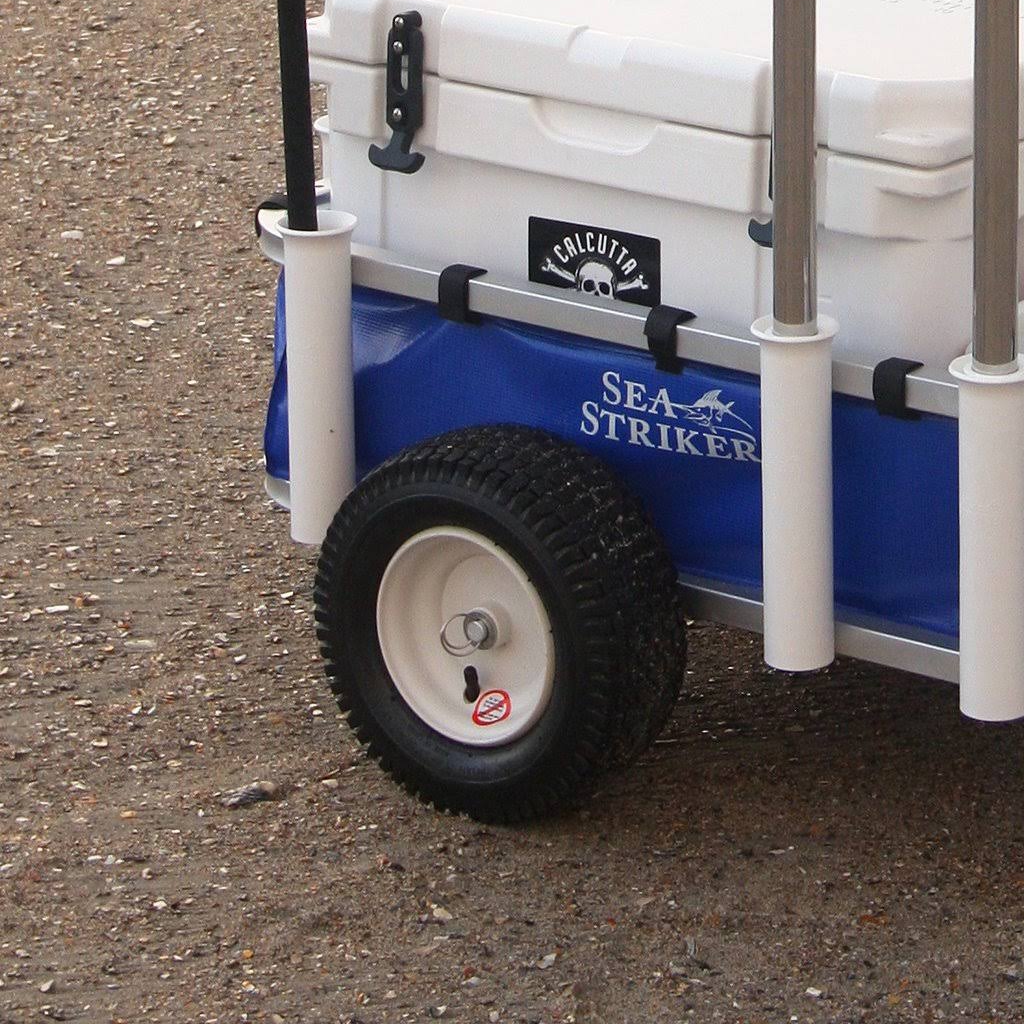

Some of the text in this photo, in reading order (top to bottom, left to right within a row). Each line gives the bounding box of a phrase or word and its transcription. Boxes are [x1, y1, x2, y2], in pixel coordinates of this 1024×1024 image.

[553, 231, 638, 275] CALCUTTA
[602, 371, 678, 419] SEA
[580, 401, 761, 463] STRIKER
